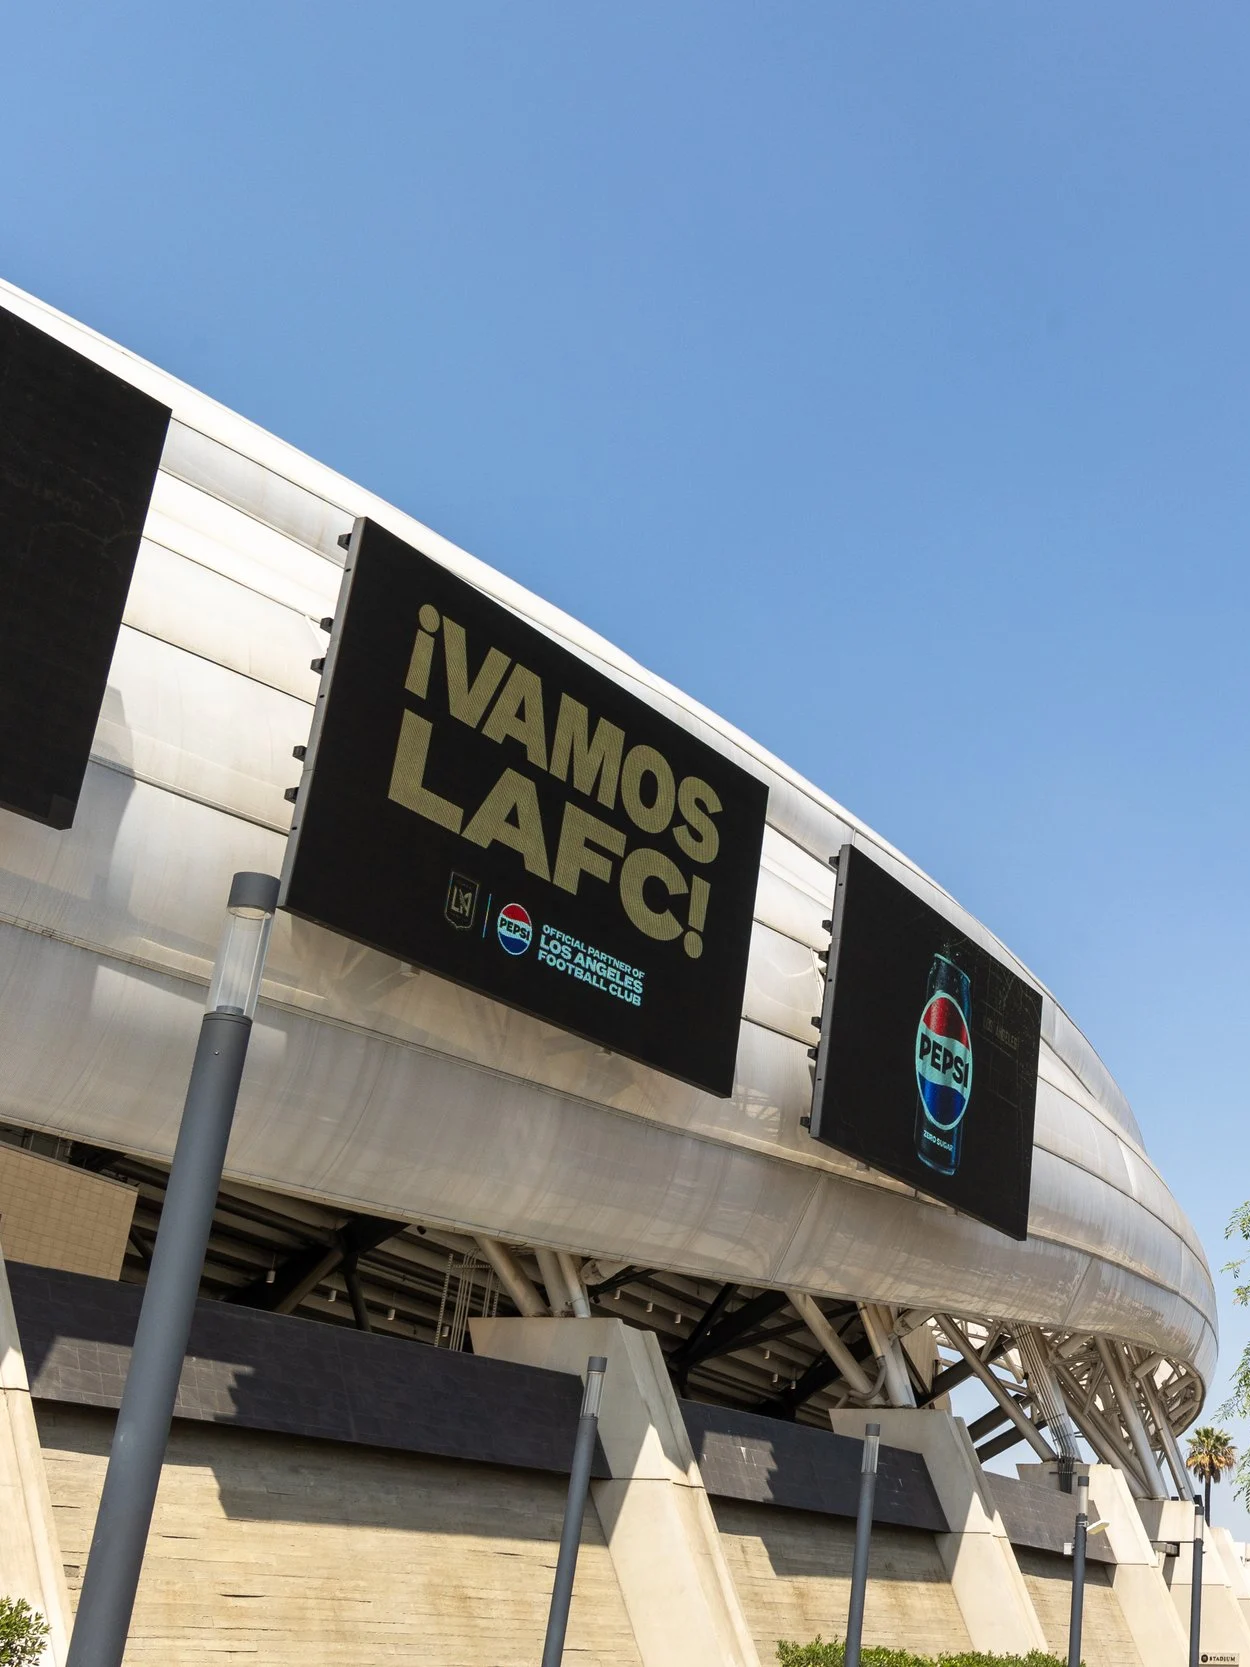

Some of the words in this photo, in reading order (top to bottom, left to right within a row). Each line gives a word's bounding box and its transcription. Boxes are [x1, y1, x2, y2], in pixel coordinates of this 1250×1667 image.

[388, 708, 711, 959] LAFC!
[499, 916, 530, 942] PEPSI
[542, 924, 587, 953] OFFICIAL
[587, 945, 632, 975] PARTNER
[632, 967, 645, 980] OF
[537, 949, 608, 992] FOOTBALL
[608, 983, 642, 1007] CLUB
[539, 934, 572, 960] LOS
[573, 952, 644, 994] ANGELES
[919, 1031, 969, 1089] PEPSI
[923, 1129, 937, 1145] ZERO
[936, 1136, 954, 1151] SUGAR
